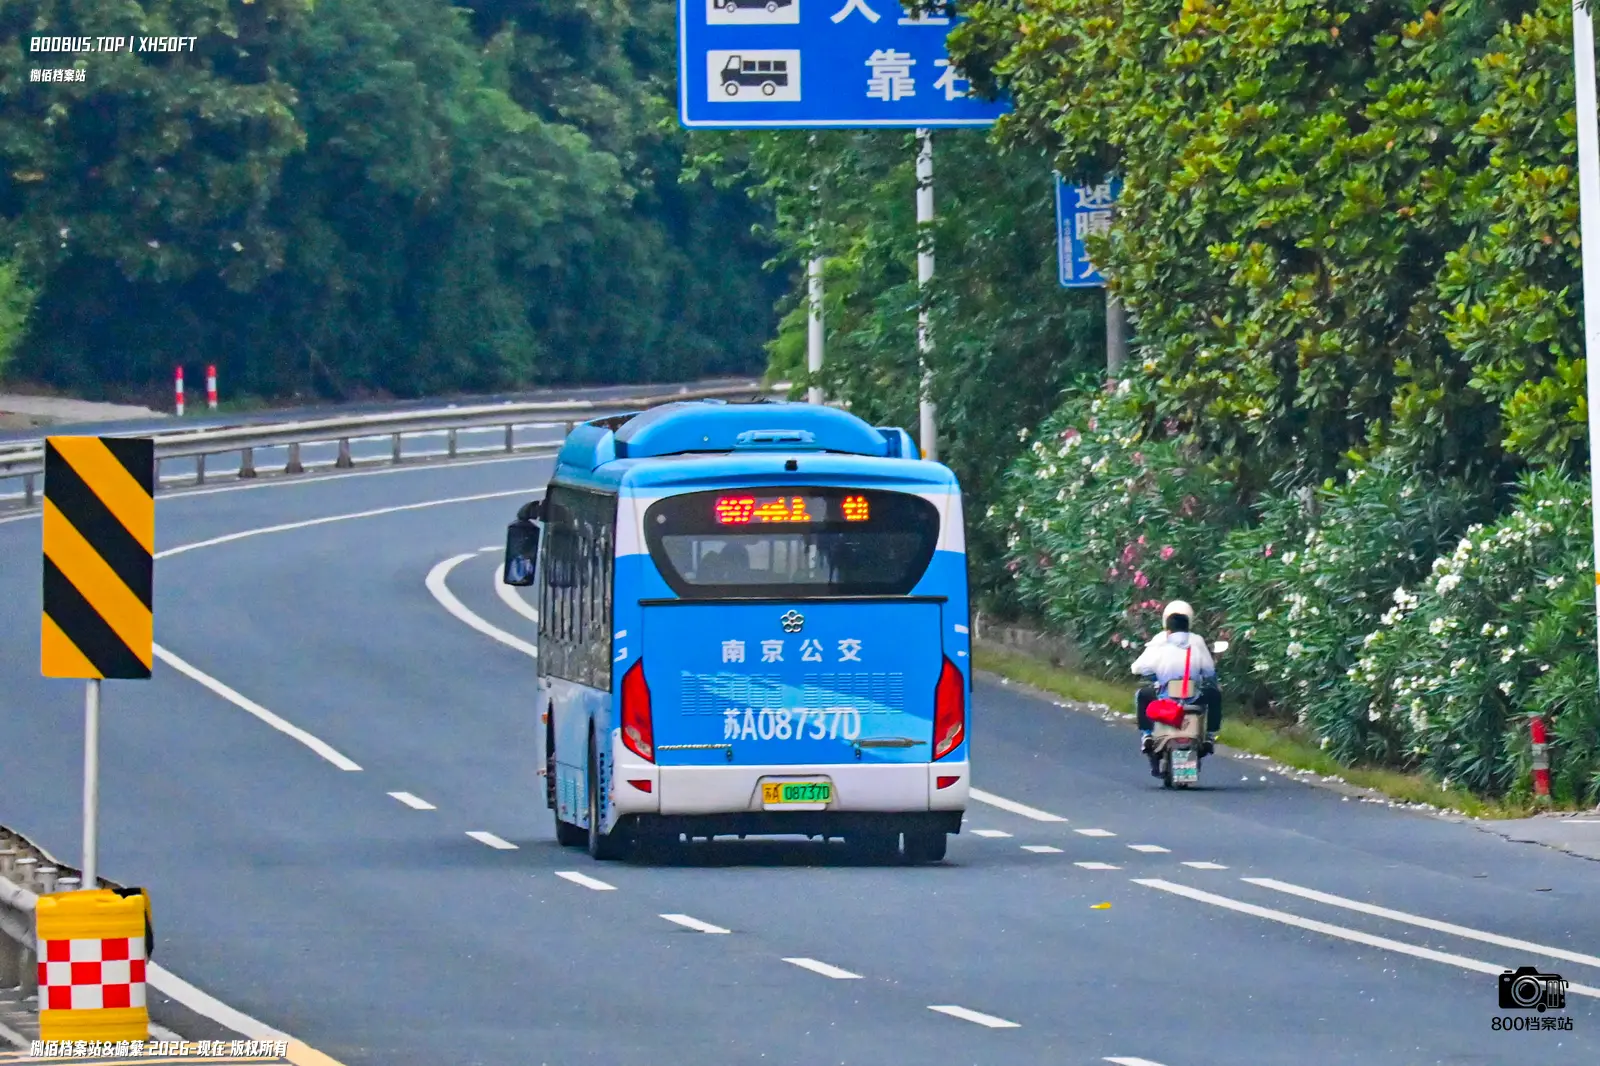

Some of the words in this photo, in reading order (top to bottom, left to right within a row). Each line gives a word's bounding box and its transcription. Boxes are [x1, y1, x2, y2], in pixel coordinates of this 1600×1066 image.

[721, 638, 862, 664] 南京公交
[723, 706, 861, 741] 苏A08737D
